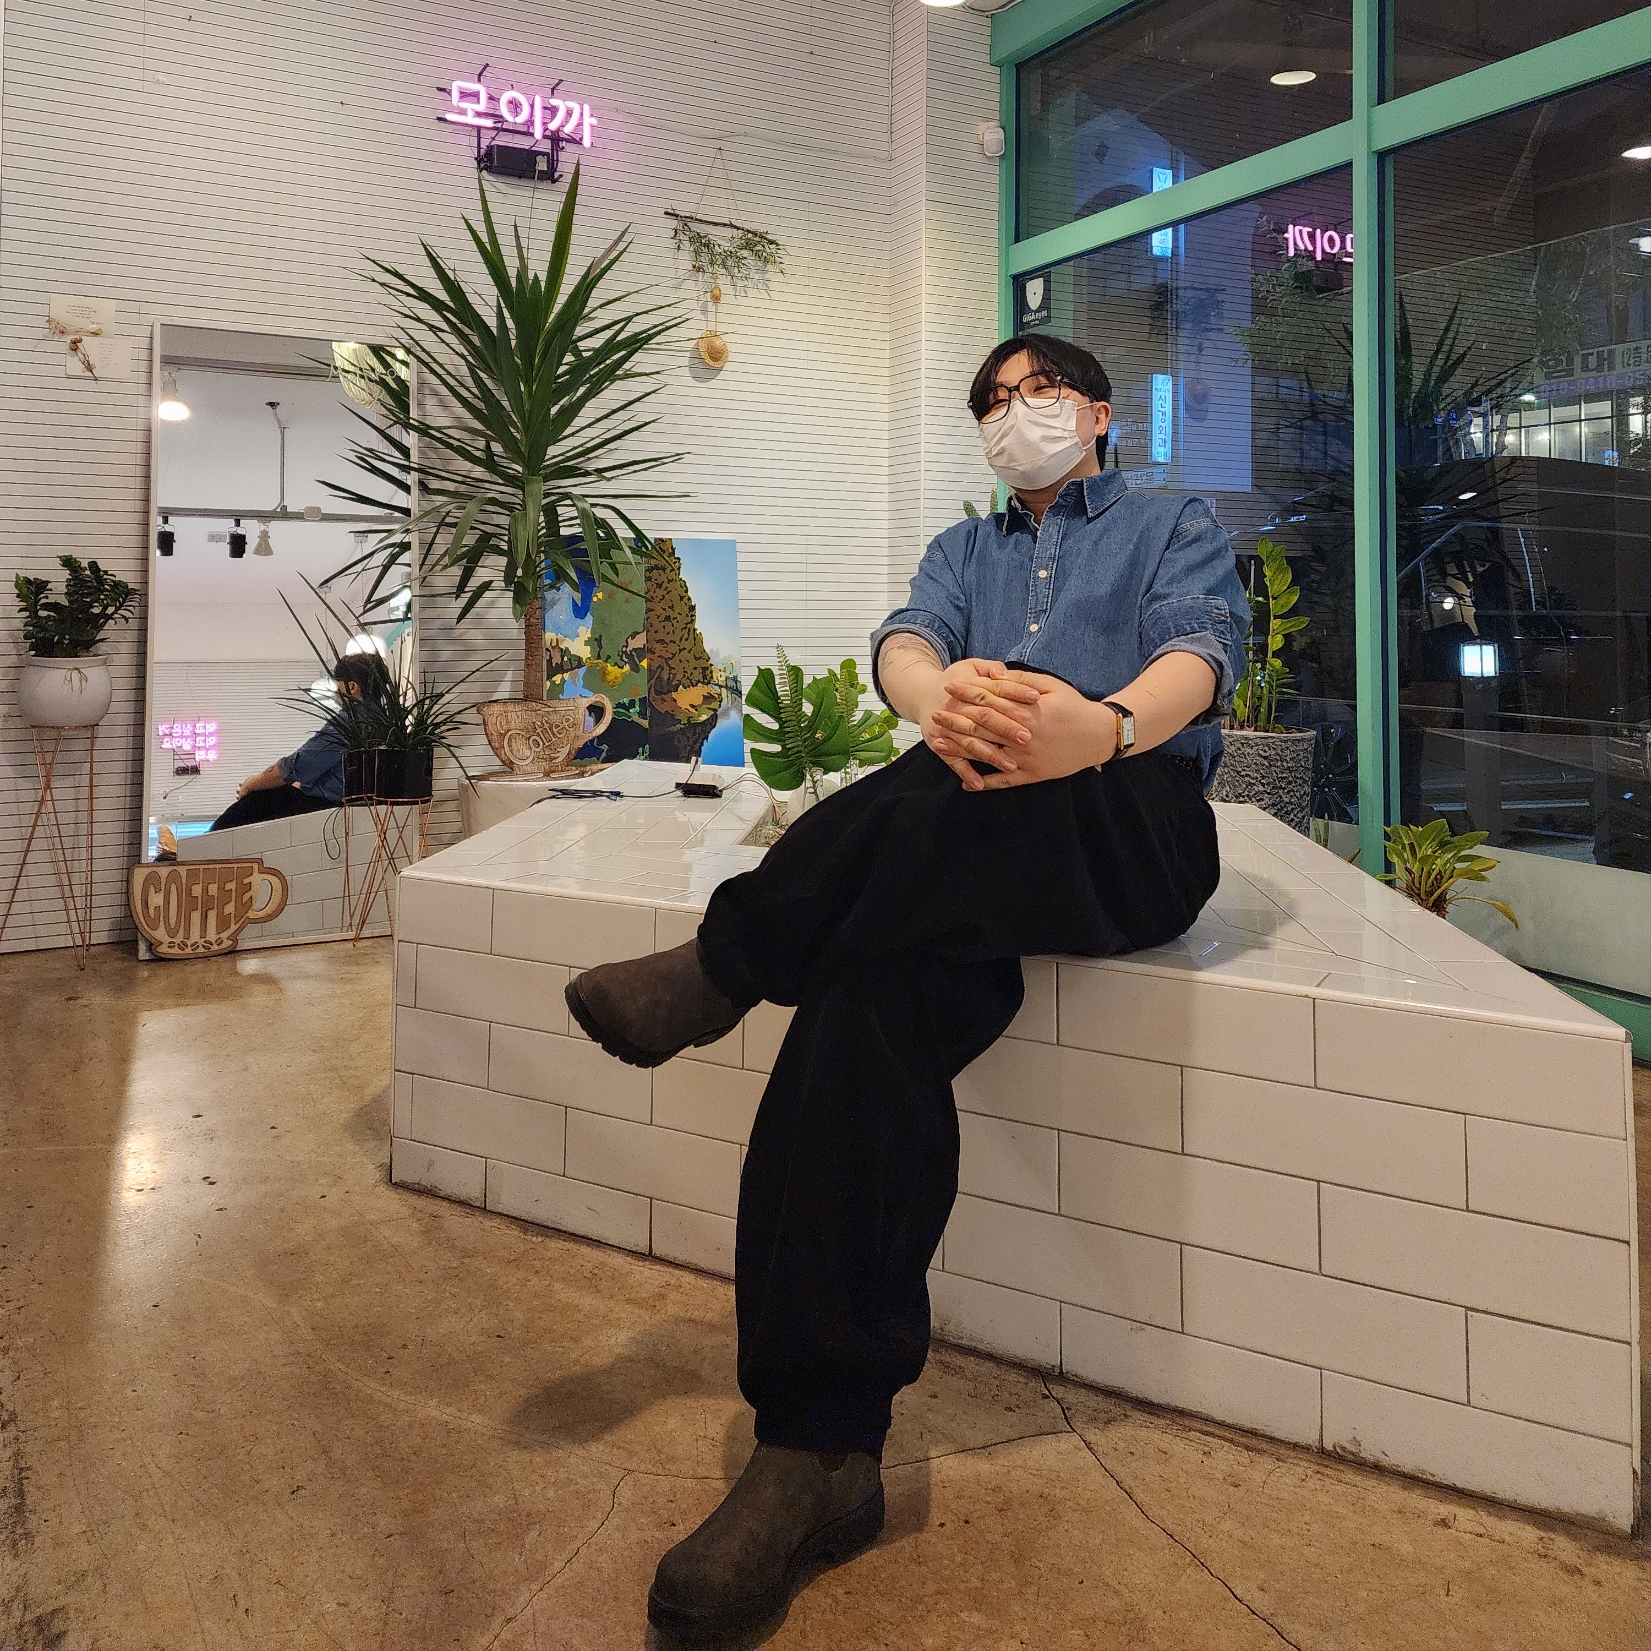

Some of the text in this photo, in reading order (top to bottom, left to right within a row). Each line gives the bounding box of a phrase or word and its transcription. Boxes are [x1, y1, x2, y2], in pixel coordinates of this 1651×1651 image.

[445, 80, 598, 148] 모이까
[1157, 394, 1168, 449] 신경외과
[504, 715, 576, 765] Coffee
[141, 866, 254, 940] COFFEE
